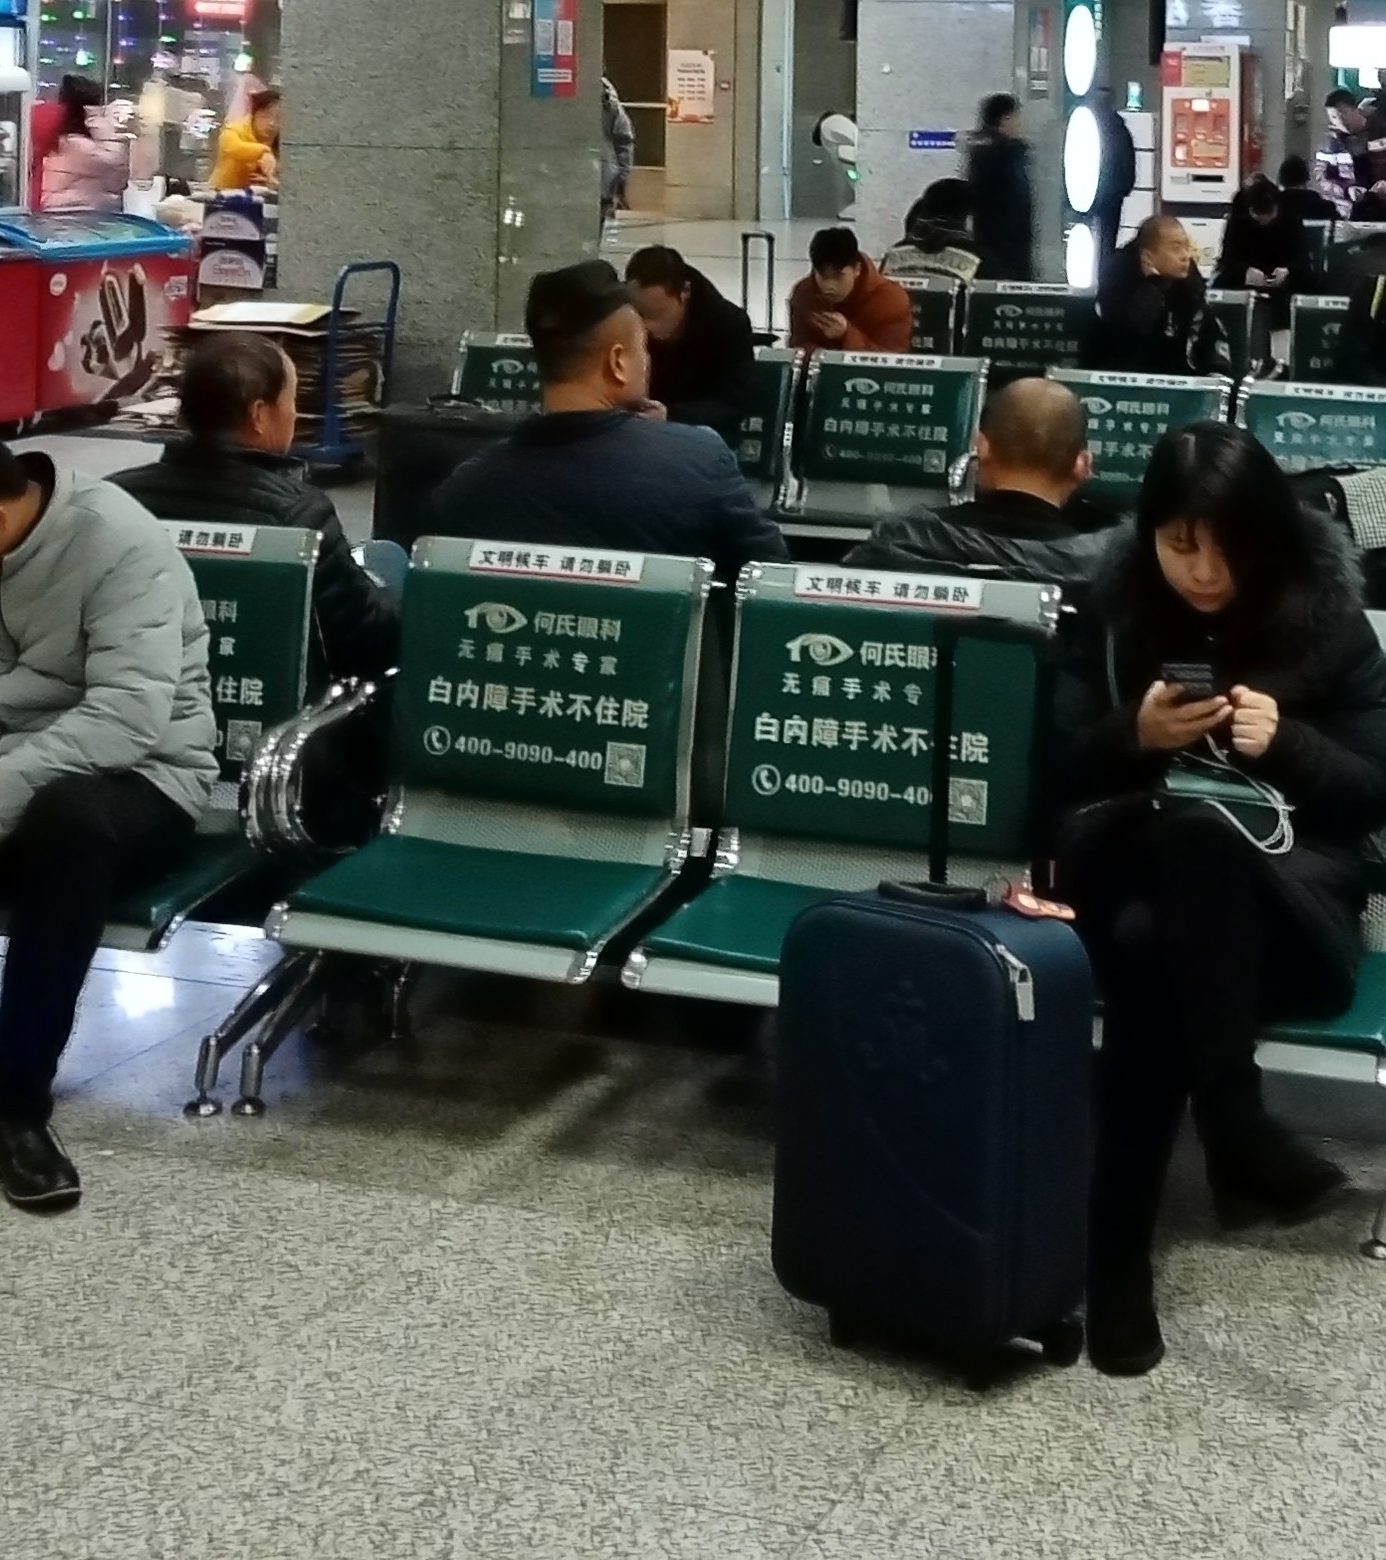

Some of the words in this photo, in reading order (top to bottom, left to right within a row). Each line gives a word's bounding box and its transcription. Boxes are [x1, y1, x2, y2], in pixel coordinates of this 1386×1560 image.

[477, 549, 551, 570] 文明候车
[560, 556, 632, 578] 请勿躺卧
[805, 575, 882, 596] 文明候车
[893, 582, 970, 603] 请勿躺卧
[533, 610, 622, 643] 何氏眼科
[457, 638, 618, 676] 无痛手术专家
[216, 676, 265, 707] 住院
[427, 675, 649, 729] 白内障手术不住院
[454, 735, 603, 771] 400-9090-400
